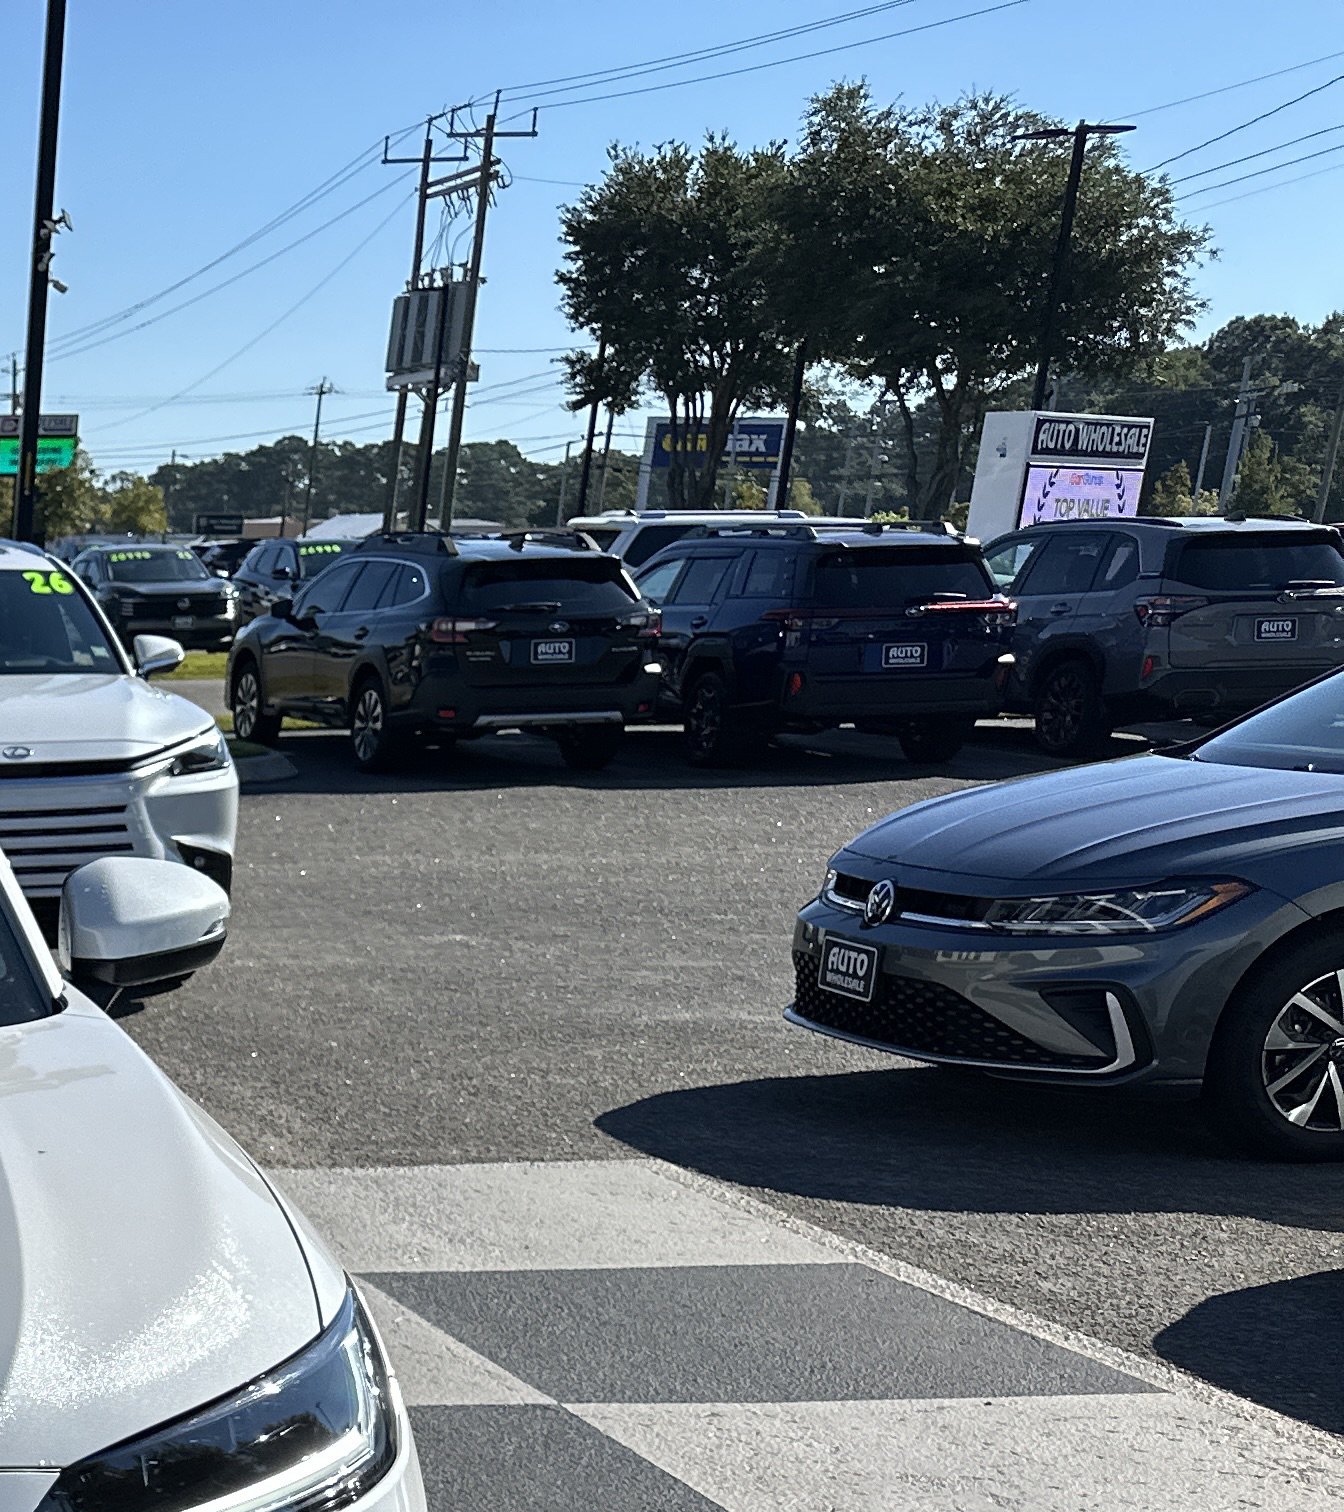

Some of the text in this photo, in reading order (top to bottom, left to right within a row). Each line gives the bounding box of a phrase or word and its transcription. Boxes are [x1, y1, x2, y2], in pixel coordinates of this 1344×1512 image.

[1037, 421, 1149, 454] AUTO WHOLESALE
[1054, 498, 1110, 517] TOP VALUE
[21, 571, 76, 595] 26
[1261, 621, 1292, 632] AUTO
[537, 642, 569, 654] AUTO
[889, 646, 921, 658] AUTO
[828, 946, 869, 977] AUTO
